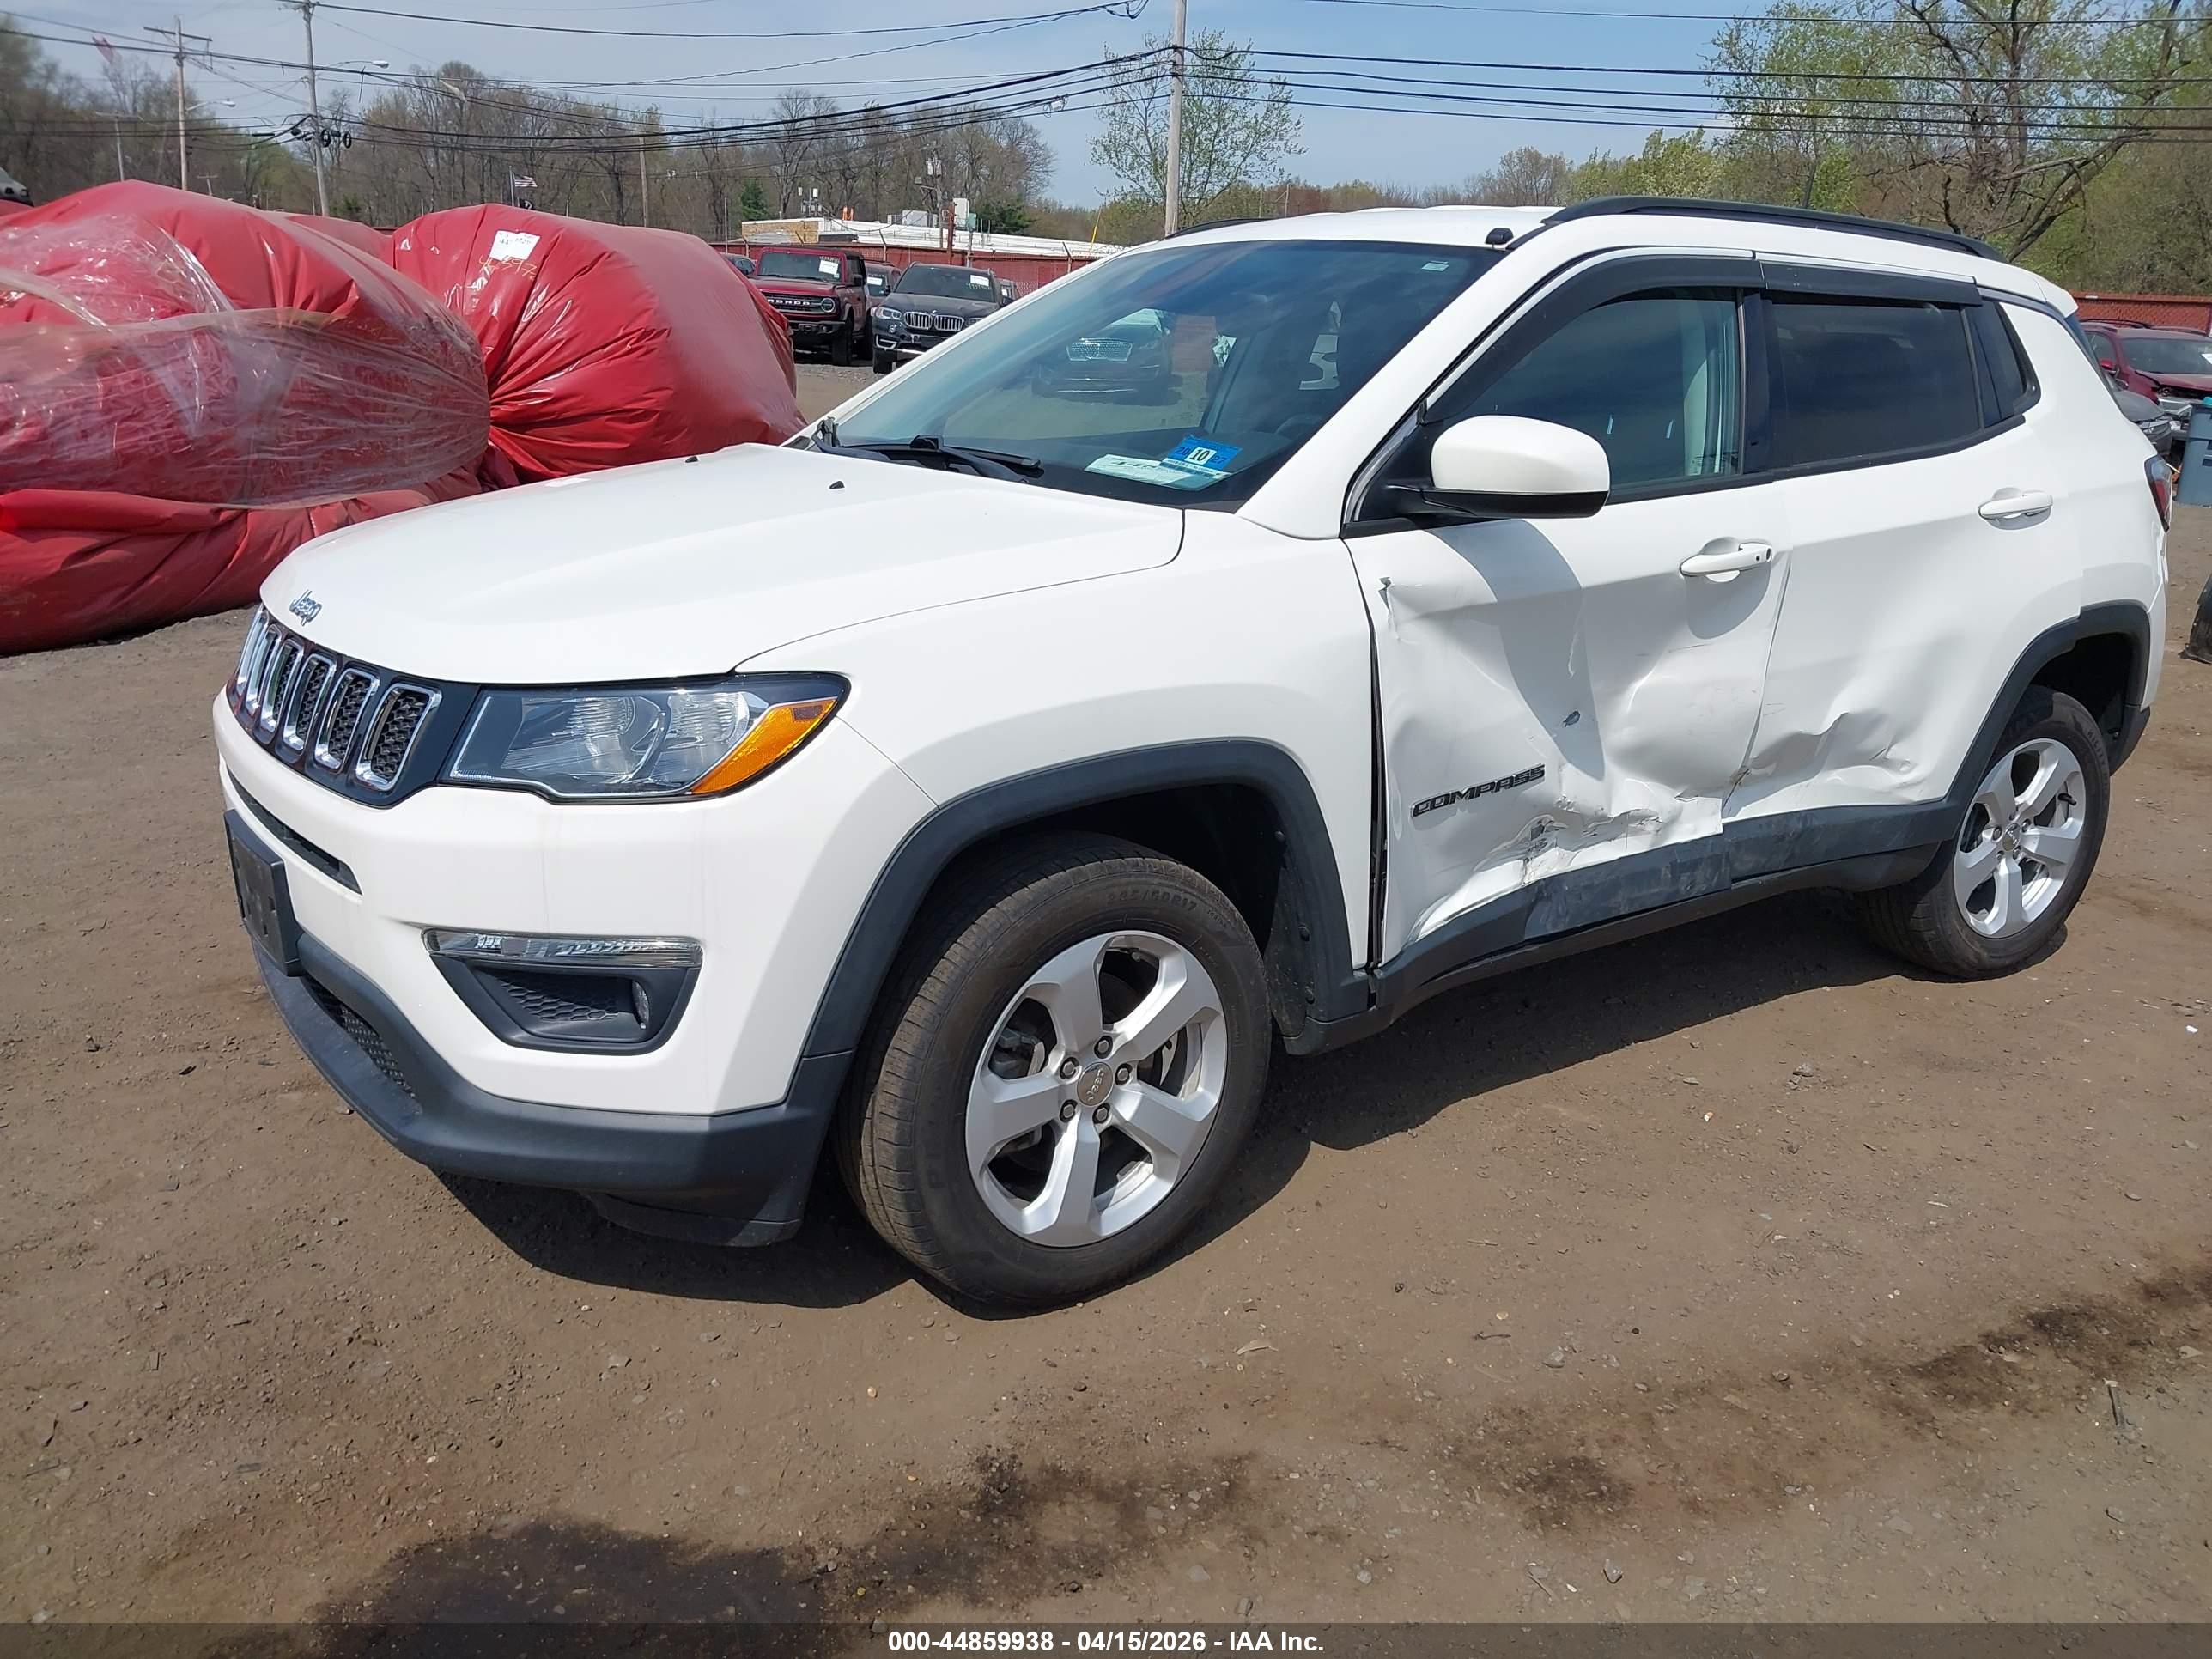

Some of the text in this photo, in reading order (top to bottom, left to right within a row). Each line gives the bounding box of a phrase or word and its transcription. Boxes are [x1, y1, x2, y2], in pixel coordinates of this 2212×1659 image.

[1189, 449, 1210, 461] 10
[1210, 455, 1229, 465] 27
[289, 589, 323, 626] Jeep
[1411, 763, 1546, 817] COMPASS
